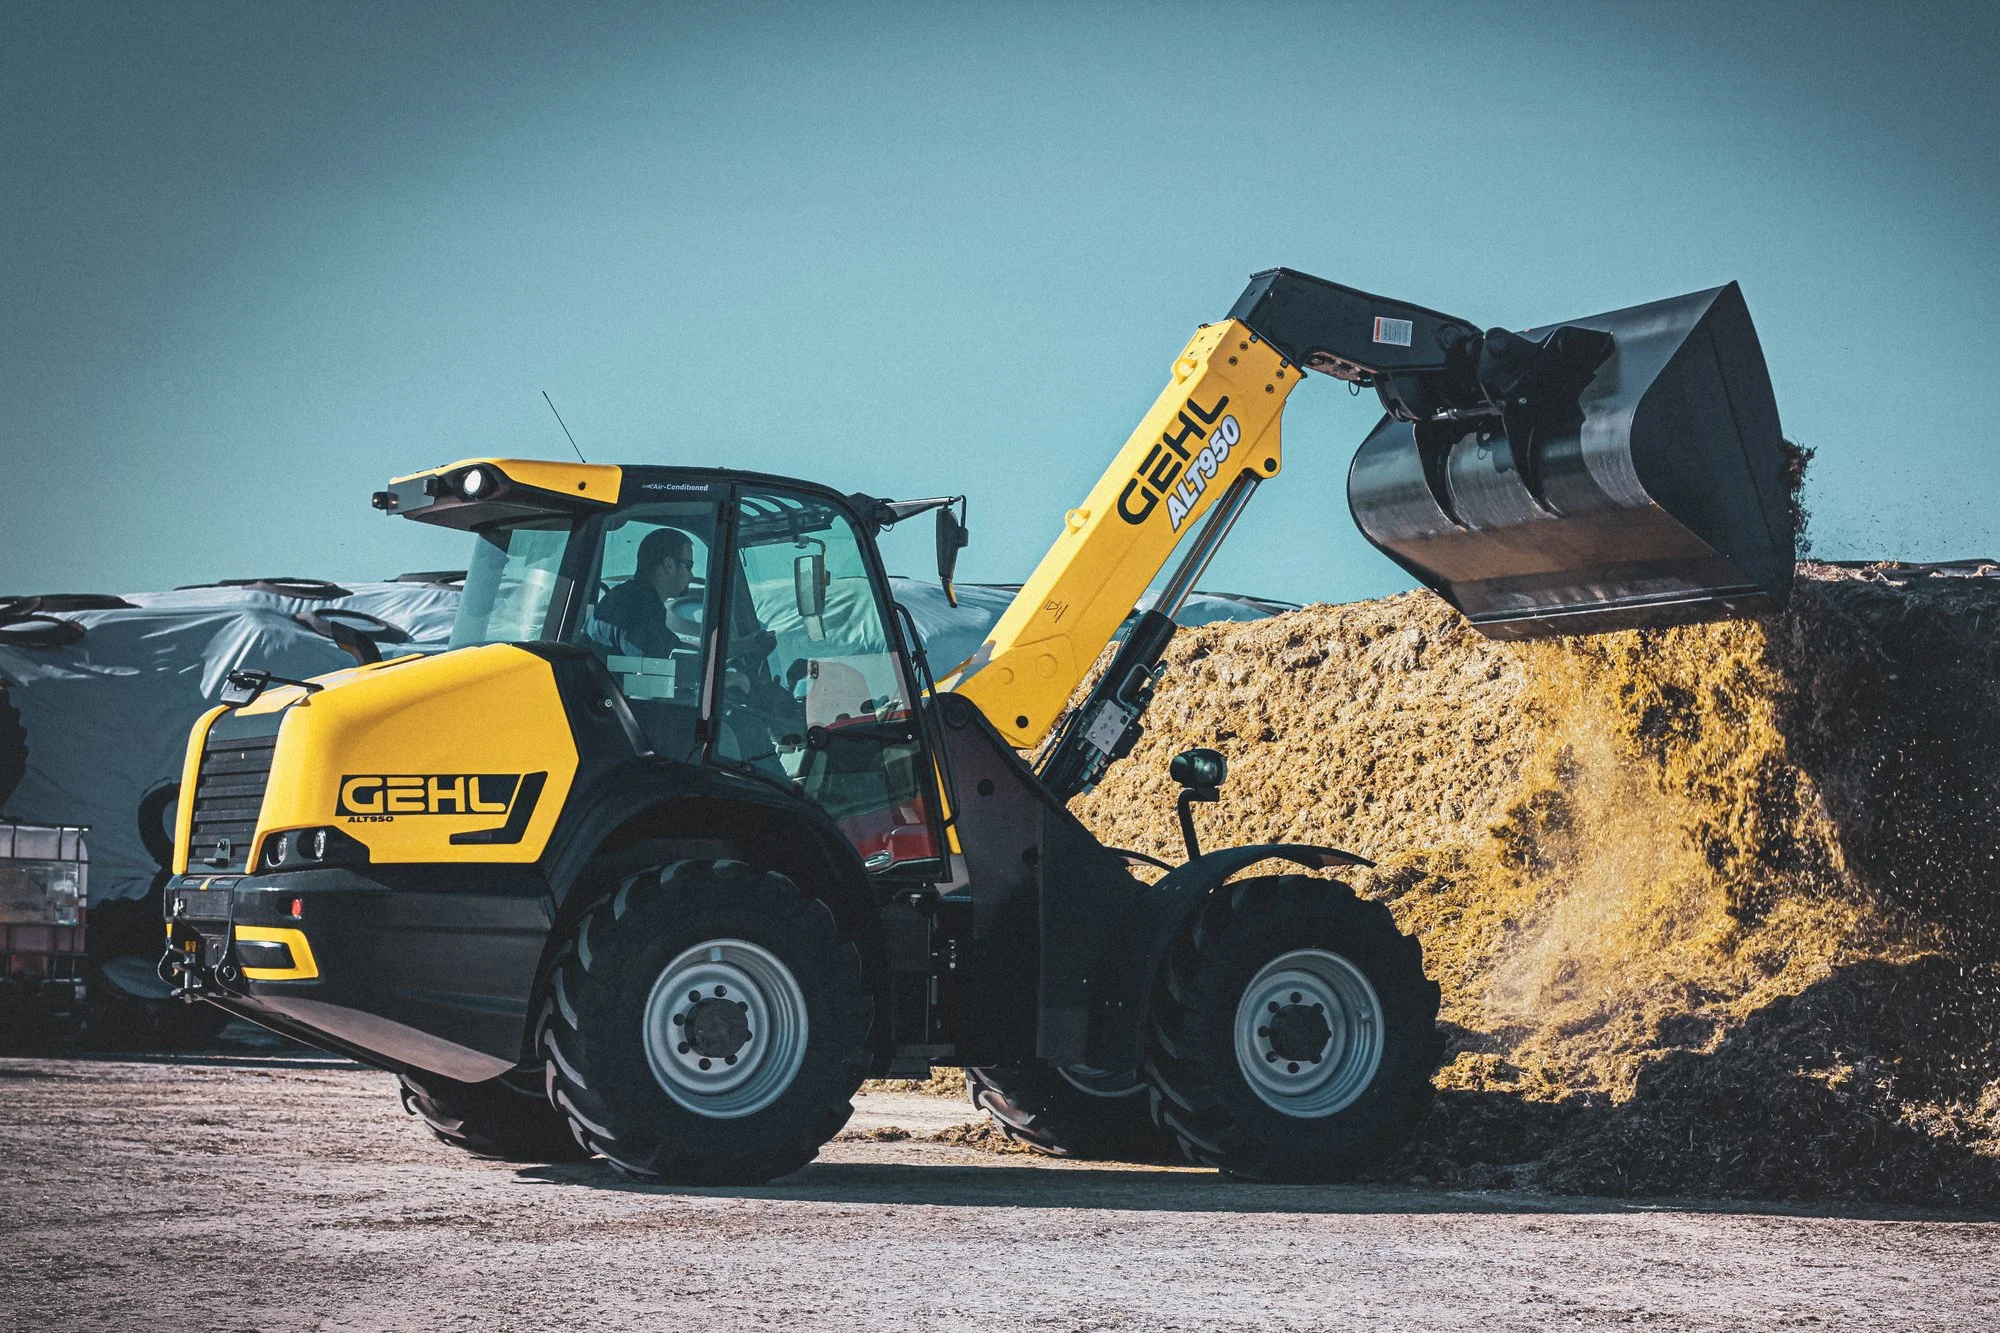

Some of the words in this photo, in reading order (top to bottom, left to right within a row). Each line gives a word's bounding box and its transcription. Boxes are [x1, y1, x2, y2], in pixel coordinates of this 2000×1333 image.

[1117, 395, 1229, 525] GEHL
[1166, 414, 1241, 533] ALT950
[652, 483, 709, 492] Air-Conditioned
[341, 776, 507, 814] GEHL
[347, 815, 395, 823] ALT950
